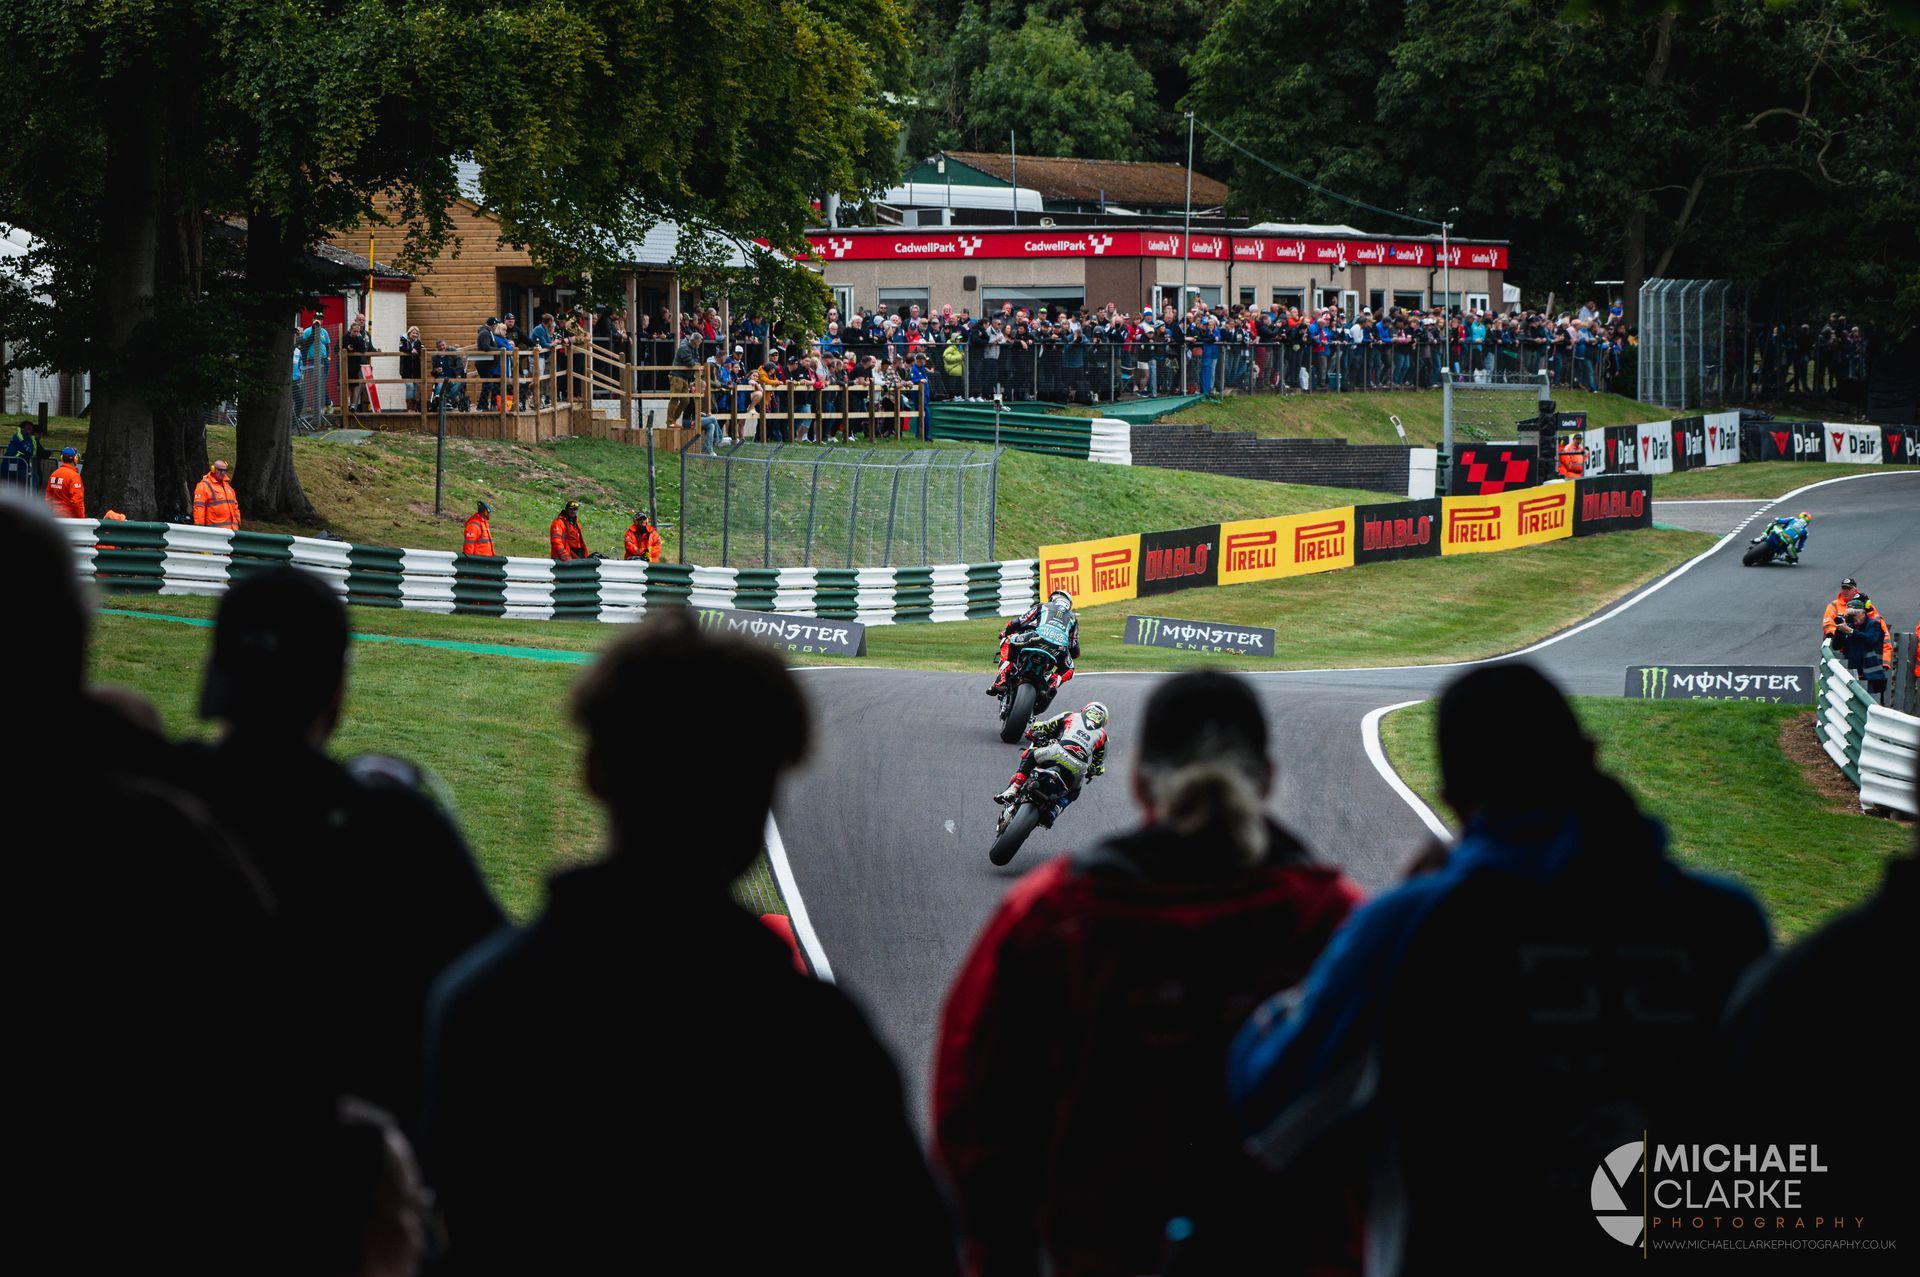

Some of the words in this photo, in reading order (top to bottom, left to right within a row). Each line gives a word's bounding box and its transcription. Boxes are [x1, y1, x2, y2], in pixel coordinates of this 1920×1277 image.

[894, 242, 956, 254] CadwellPark
[1024, 240, 1086, 252] CadwellPark
[1449, 505, 1501, 544] PIRELLI
[1517, 493, 1567, 536] PIRELLI
[1581, 489, 1644, 522] DIABLO
[1226, 530, 1277, 572] PIRELLI
[1294, 520, 1346, 563] PIRELLI
[1362, 514, 1431, 551] DIABLO
[1046, 556, 1080, 600] PIRELLI
[1091, 548, 1131, 593] PIRELLI
[1144, 542, 1208, 582] DIABLO
[1162, 625, 1264, 648] MONSTER
[1673, 671, 1802, 692] MONSTER
